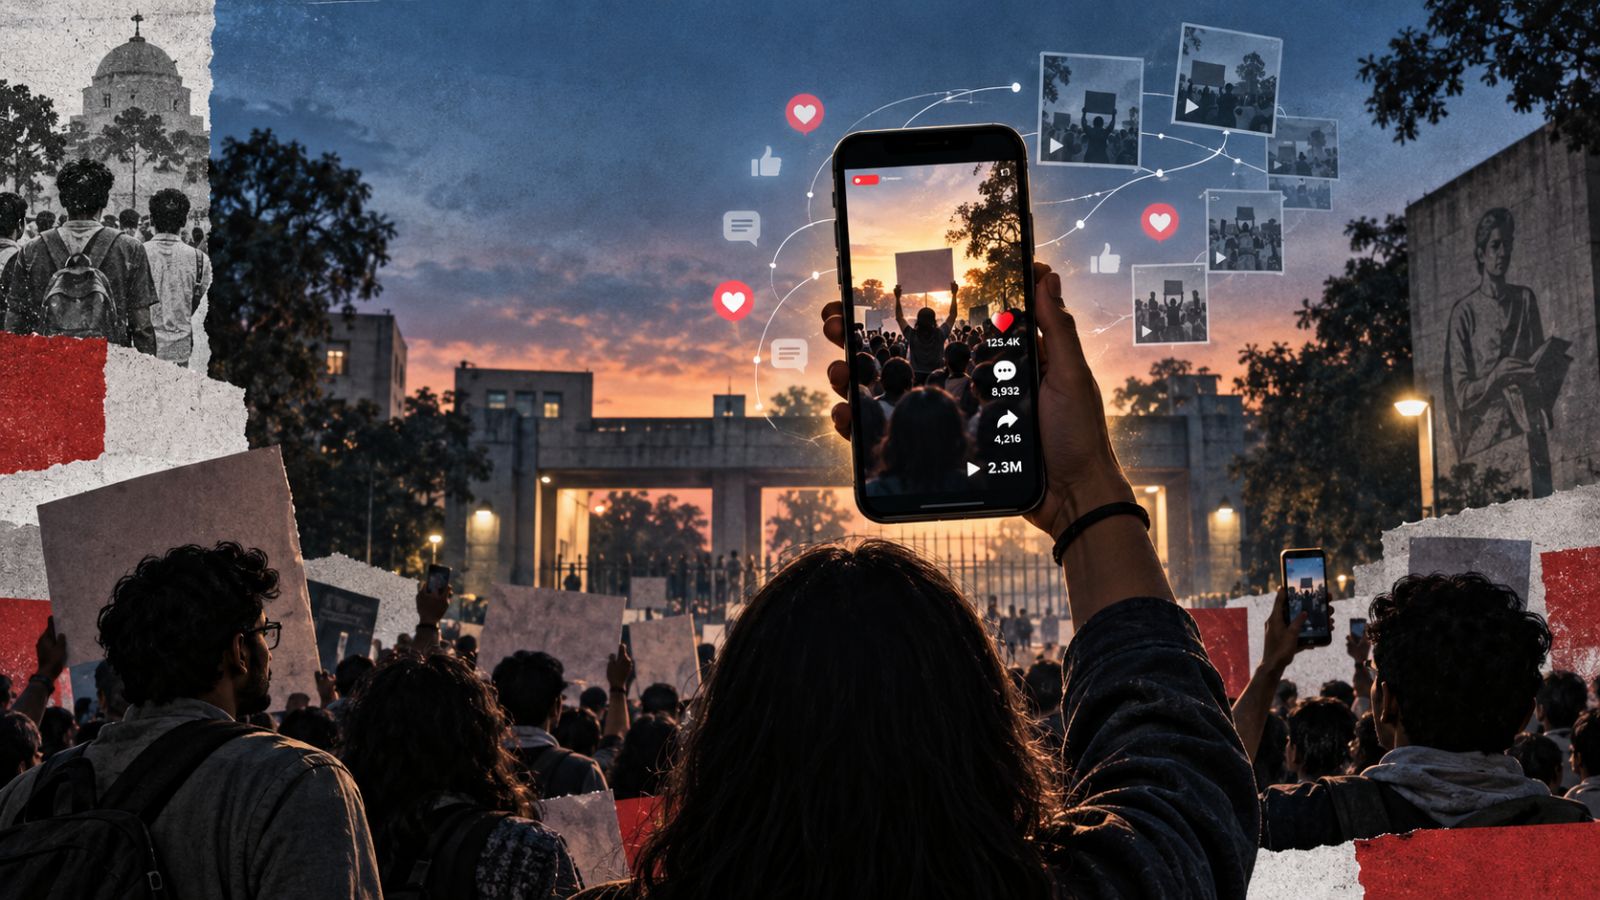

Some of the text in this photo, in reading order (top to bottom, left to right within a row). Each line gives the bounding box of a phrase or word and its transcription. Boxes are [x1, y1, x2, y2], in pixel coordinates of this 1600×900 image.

[986, 337, 1020, 347] 125.4K
[991, 386, 1020, 397] 8,932
[994, 434, 1022, 444] 4,216
[988, 461, 1022, 474] 2.3M
